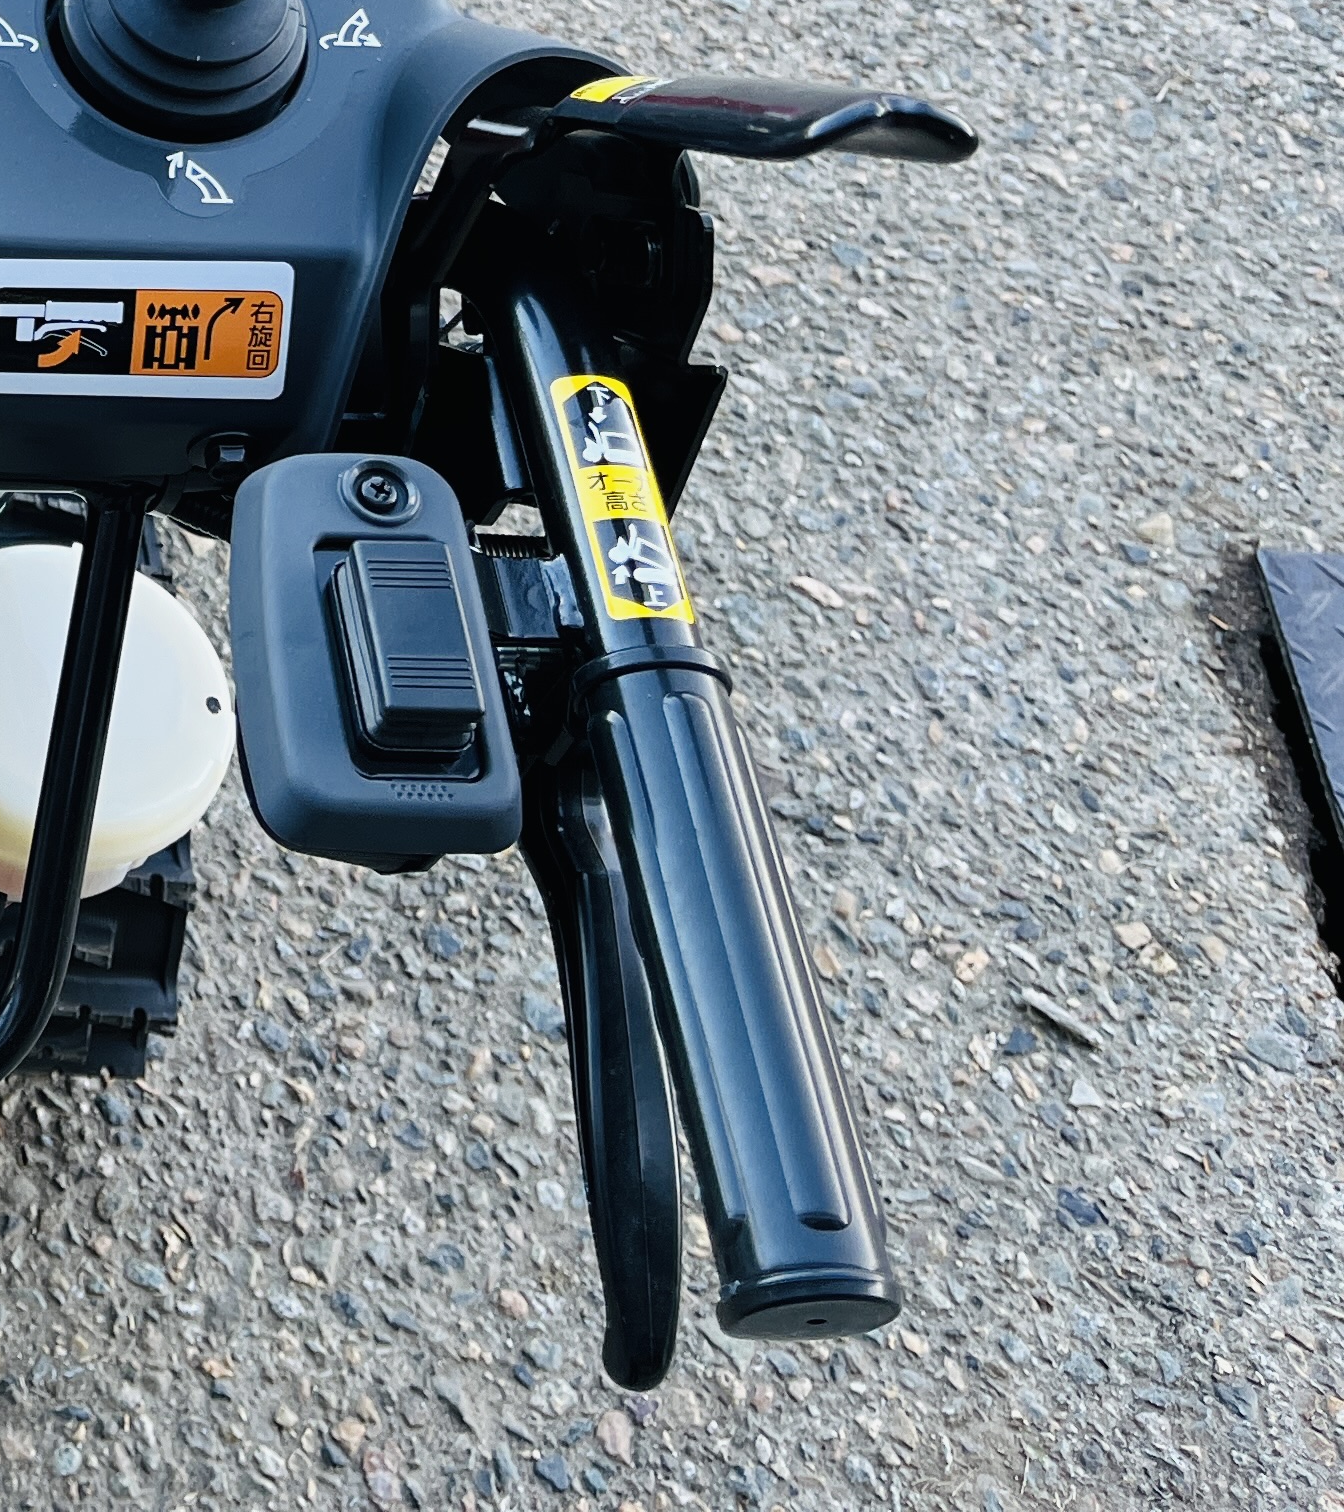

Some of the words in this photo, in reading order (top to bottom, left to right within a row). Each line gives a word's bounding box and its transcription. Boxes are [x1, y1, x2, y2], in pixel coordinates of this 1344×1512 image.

[246, 301, 276, 370] 右旋回
[587, 387, 610, 407] 下
